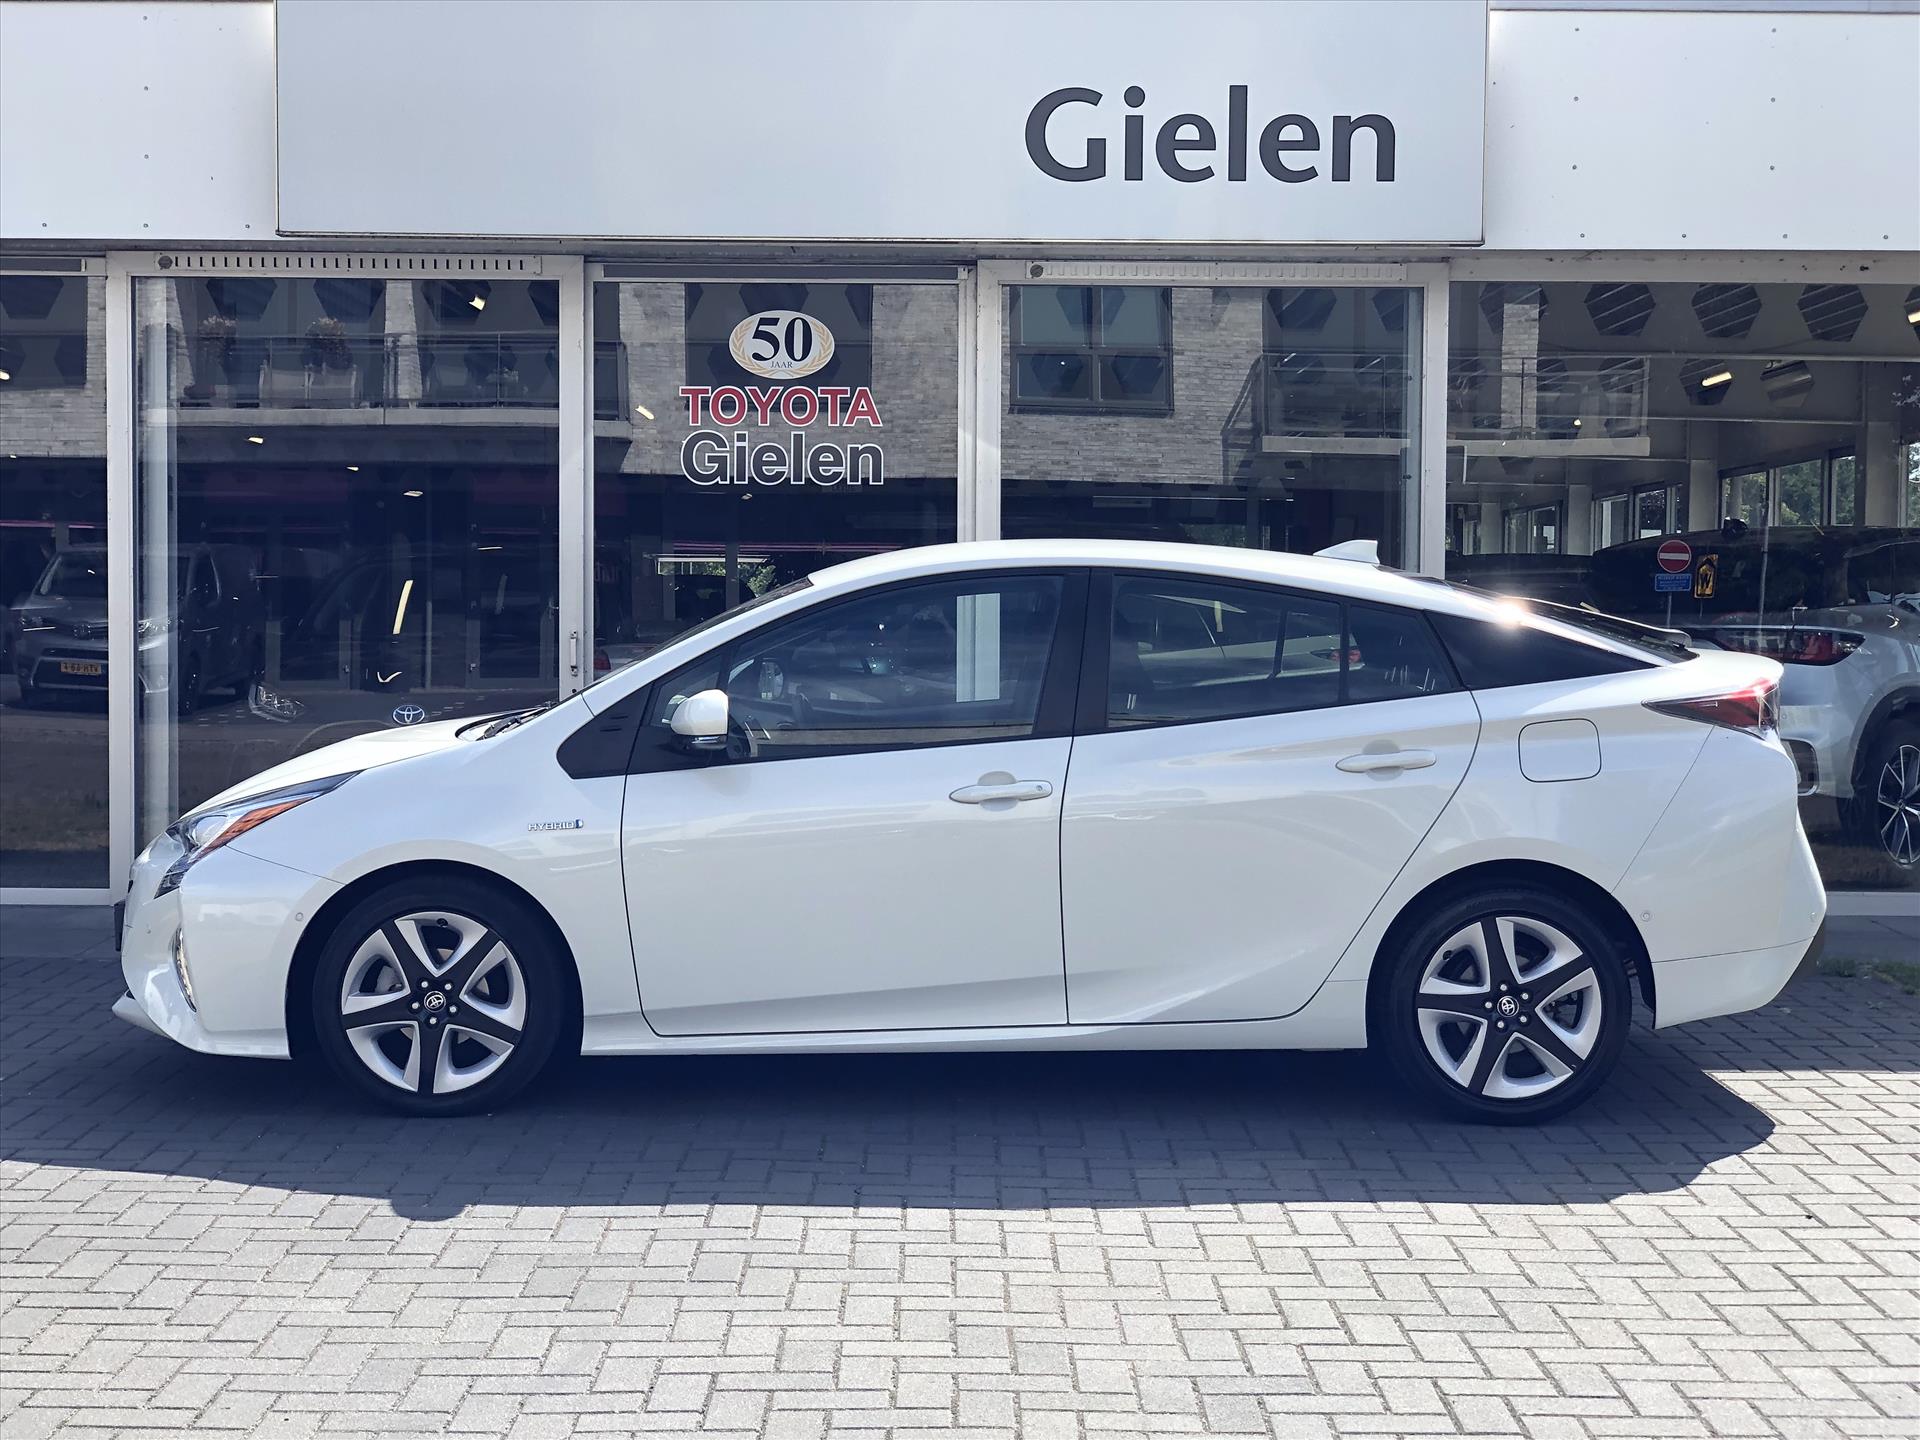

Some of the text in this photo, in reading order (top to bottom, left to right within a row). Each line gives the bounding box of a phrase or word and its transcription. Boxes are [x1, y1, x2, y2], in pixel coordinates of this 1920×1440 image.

[1024, 84, 1397, 183] Gielen
[751, 316, 813, 362] 50
[770, 360, 794, 369] JAAR
[679, 385, 883, 426] TOYOTA
[680, 429, 885, 486] Gielen
[527, 821, 576, 832] HYBRID
